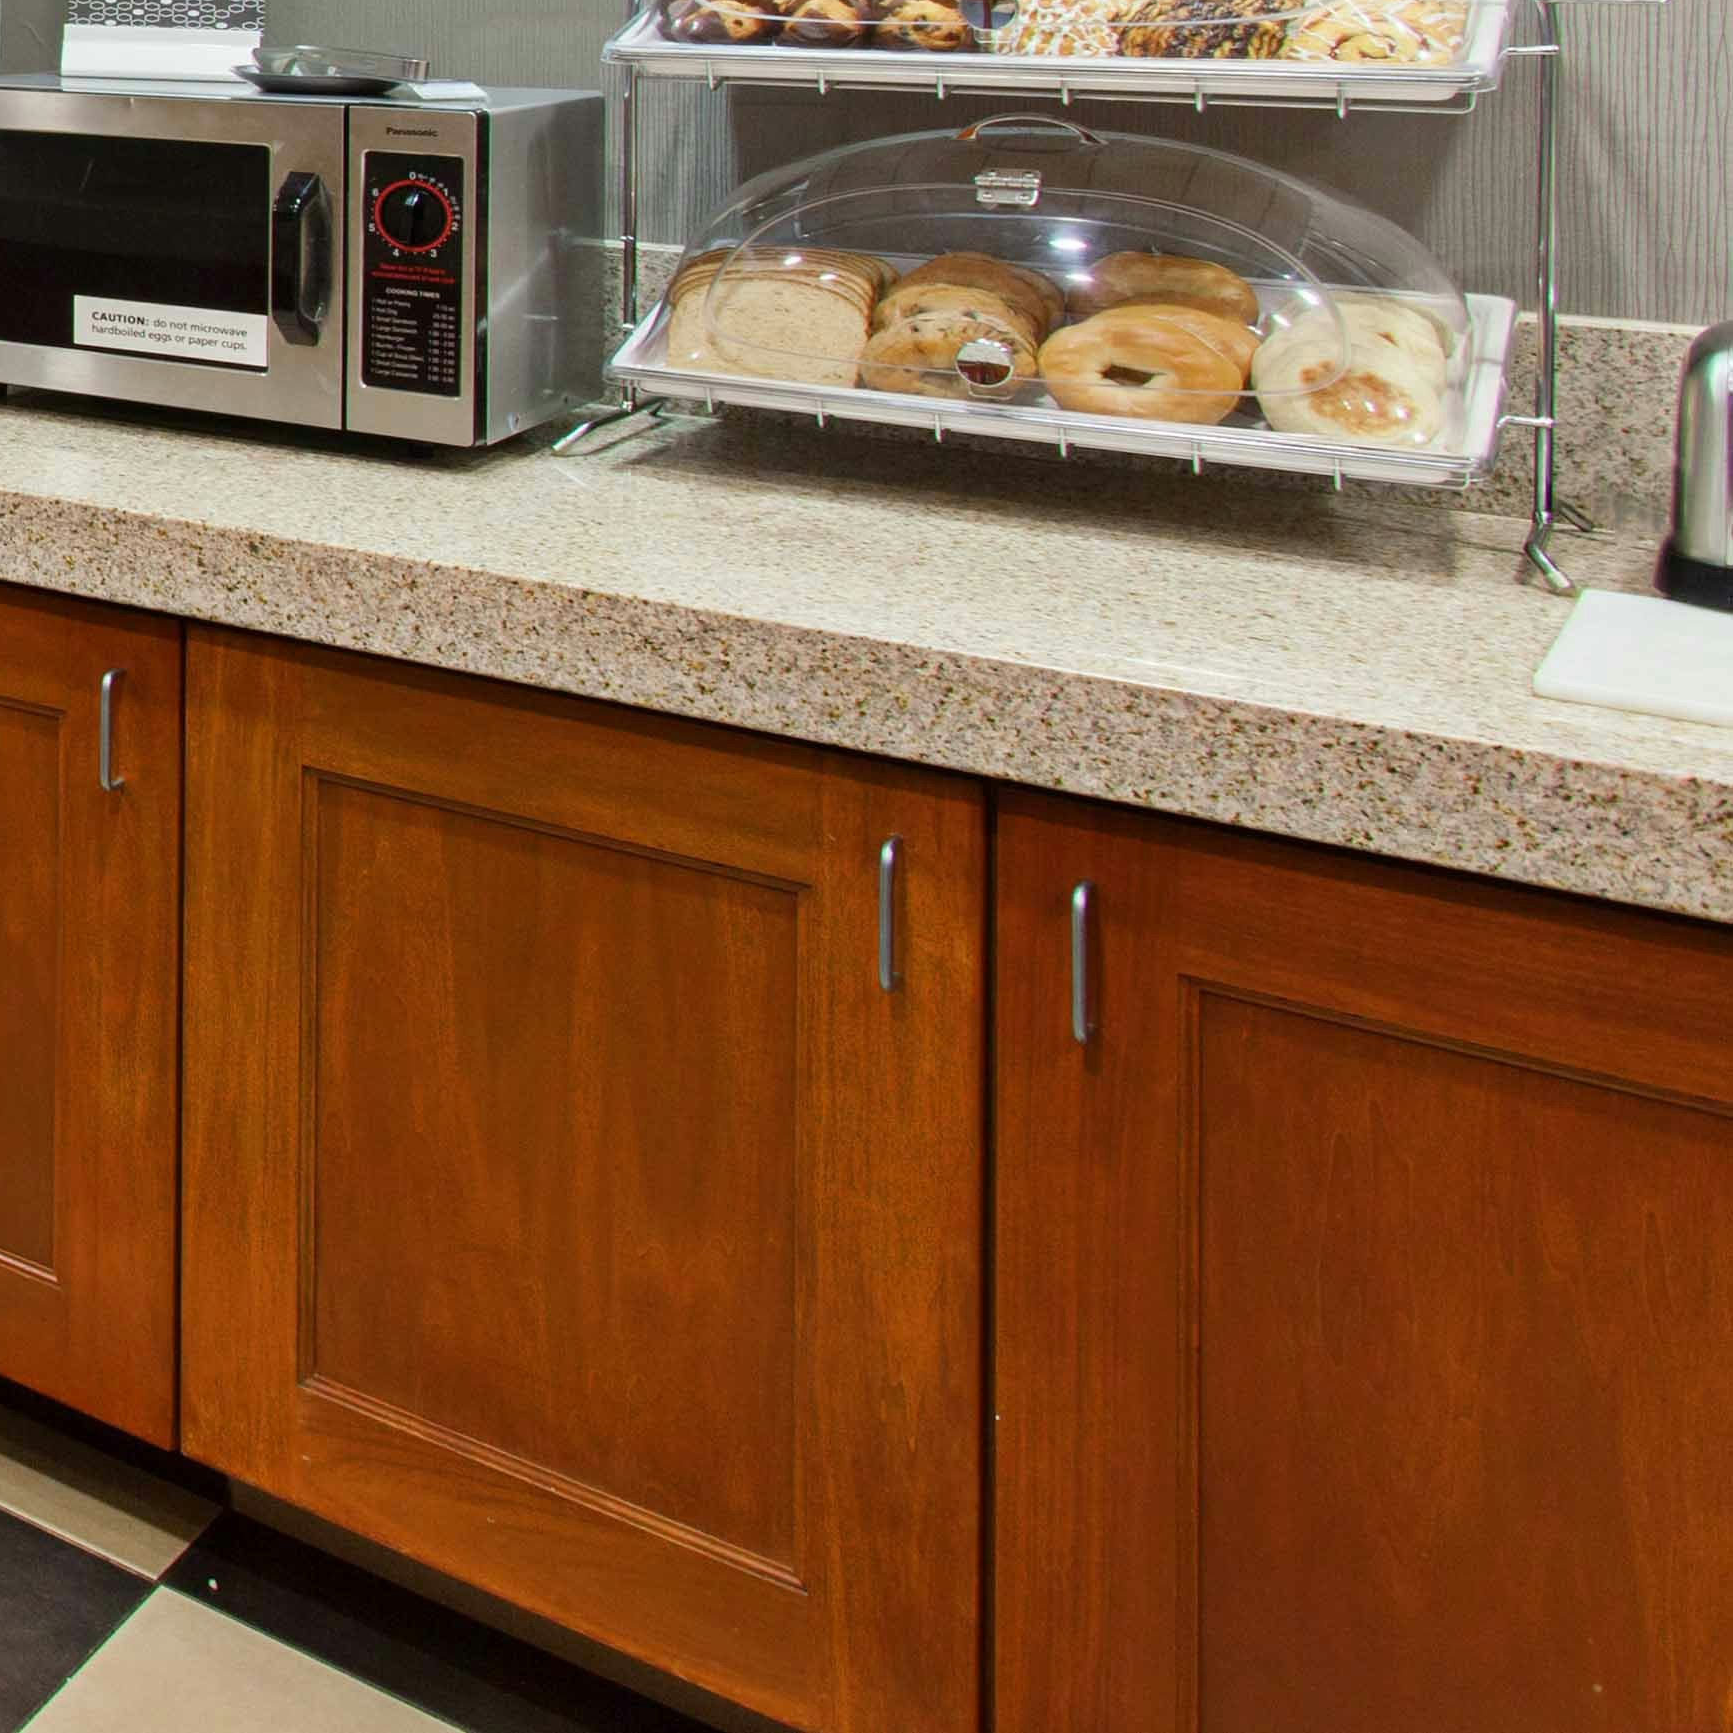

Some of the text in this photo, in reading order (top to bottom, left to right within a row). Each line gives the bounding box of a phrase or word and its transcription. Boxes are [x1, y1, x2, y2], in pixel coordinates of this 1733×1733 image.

[386, 127, 439, 137] Panasonic
[92, 311, 247, 337] CAUTION: do not microwave
[92, 324, 247, 351] hardboiled eggs or paper cups.
